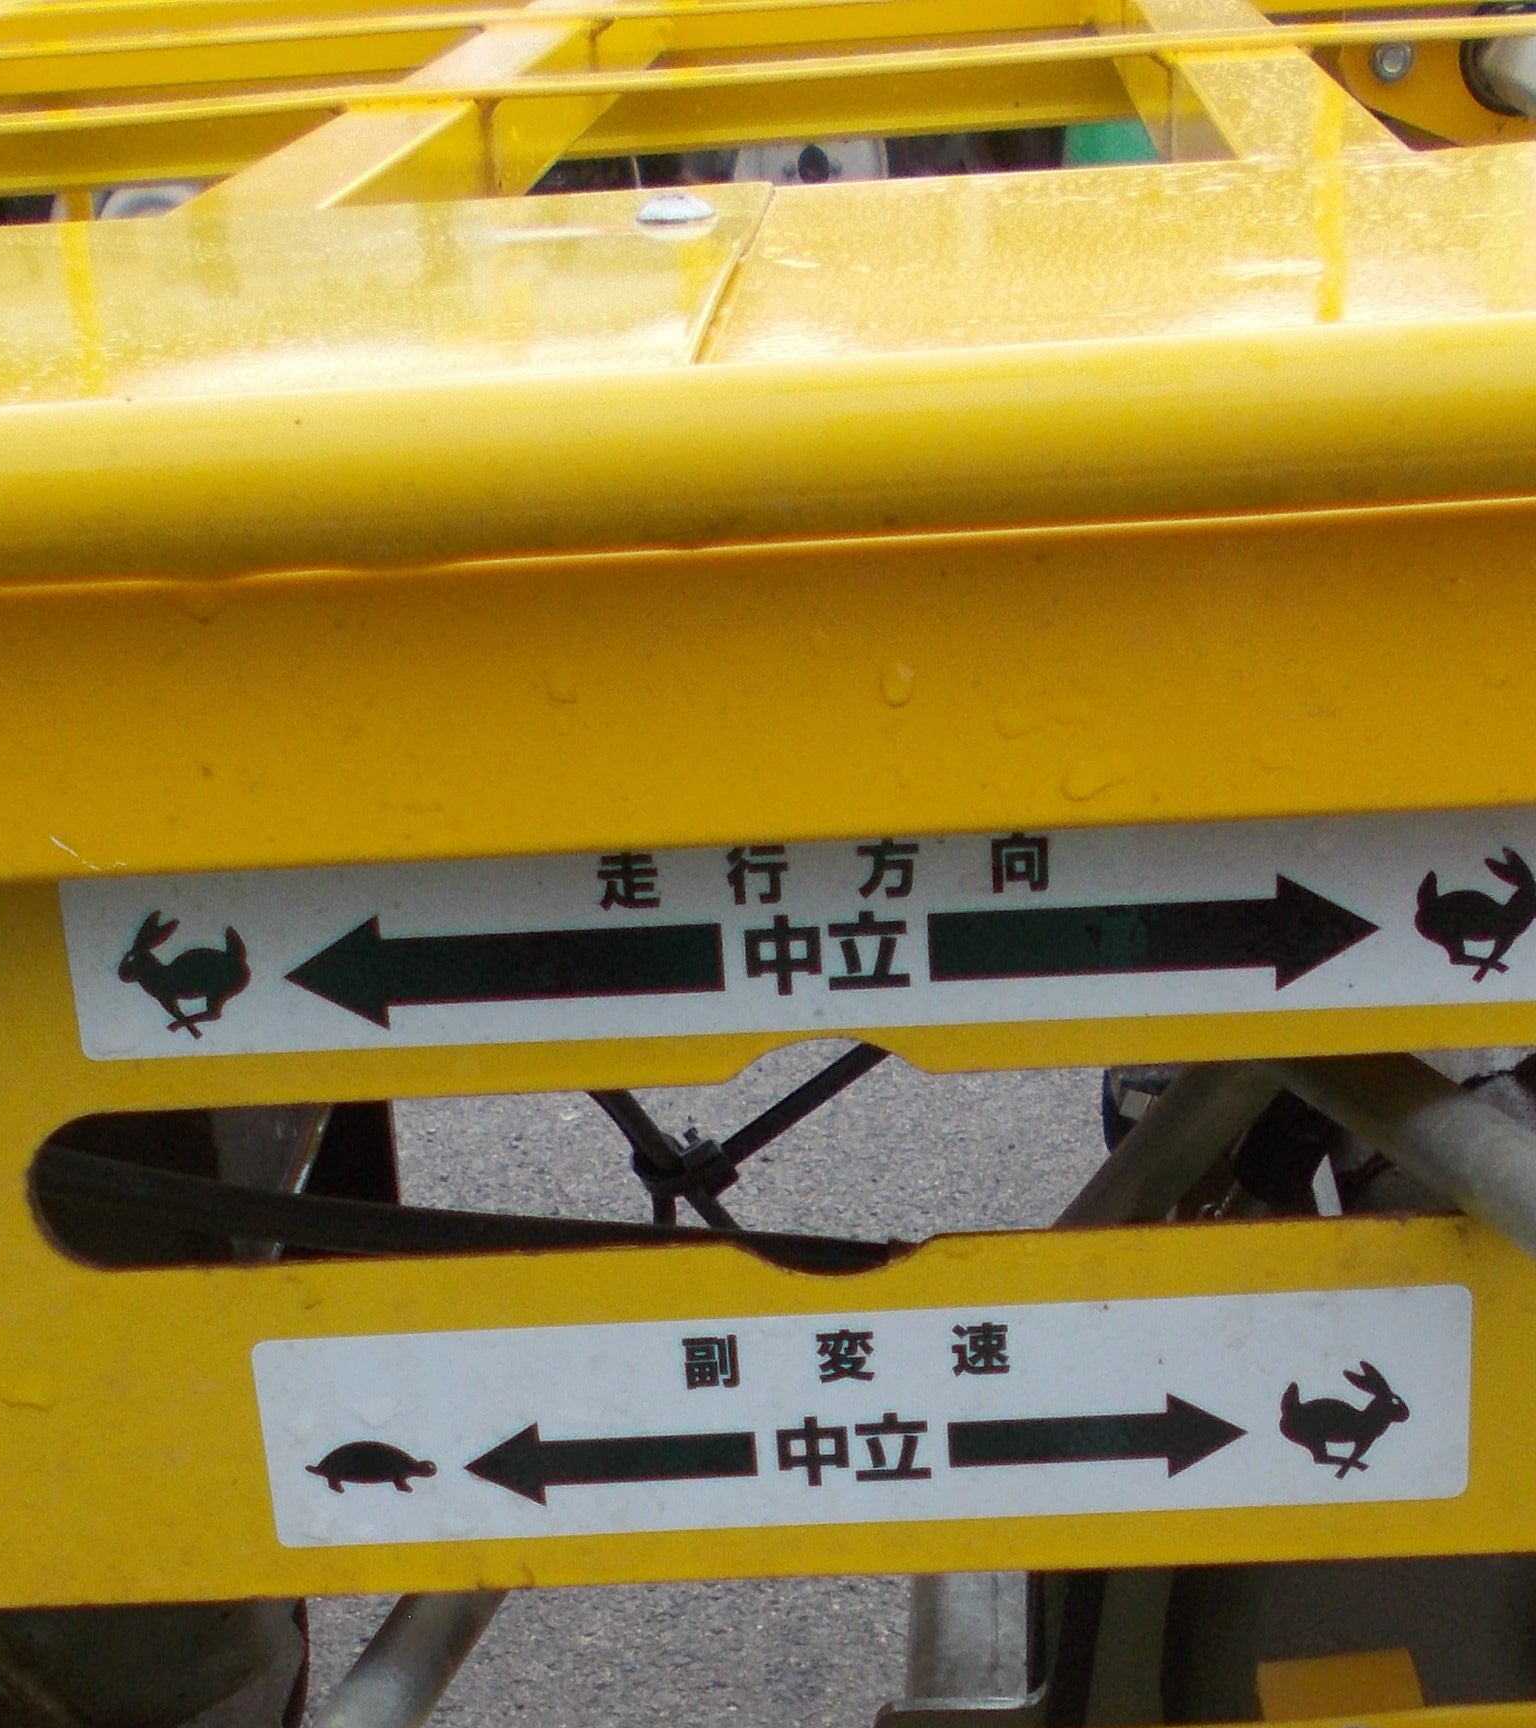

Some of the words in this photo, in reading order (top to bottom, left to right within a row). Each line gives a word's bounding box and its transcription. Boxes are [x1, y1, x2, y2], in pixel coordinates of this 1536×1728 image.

[597, 832, 1048, 910] 走行方向
[744, 911, 911, 996] 中立
[683, 1323, 1012, 1390] 副変速
[775, 1411, 932, 1487] 中立
